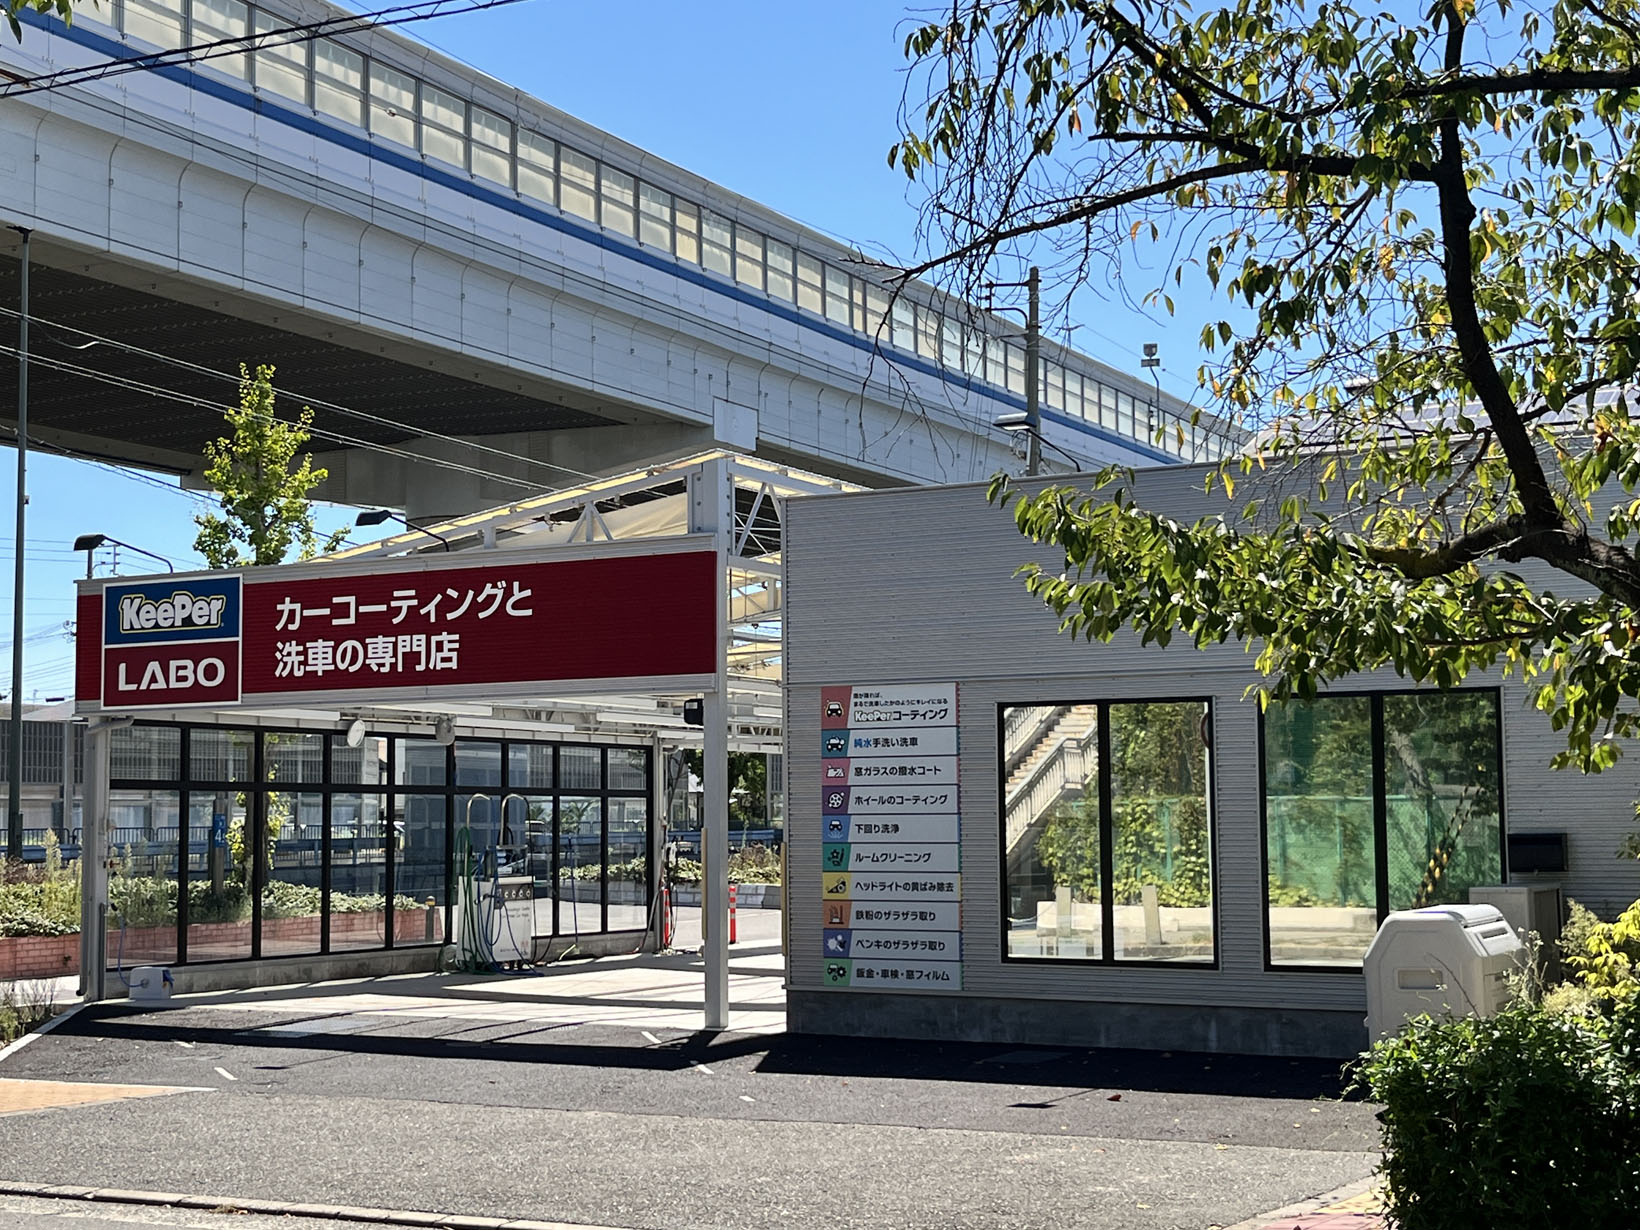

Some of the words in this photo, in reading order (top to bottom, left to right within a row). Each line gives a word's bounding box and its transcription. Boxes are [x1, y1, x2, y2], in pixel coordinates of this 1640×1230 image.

[275, 580, 533, 632] カーコーティングと
[119, 591, 226, 634] KeePer
[275, 632, 460, 678] 洗車の専門店
[118, 657, 224, 692] LABO
[854, 737, 918, 748] 純水手洗い洗車
[854, 765, 942, 777] 窓ガラスの撥水コート
[854, 794, 948, 805] ホイールのコーティング
[855, 823, 899, 834] 下回り洗浄
[855, 852, 931, 863] ルームクリーニング
[855, 881, 954, 893] ヘッドライトの黄ばみ除去
[855, 910, 936, 921] 鉄粉のザラザラ取り
[856, 939, 945, 951] ペンキのザラザラ取り
